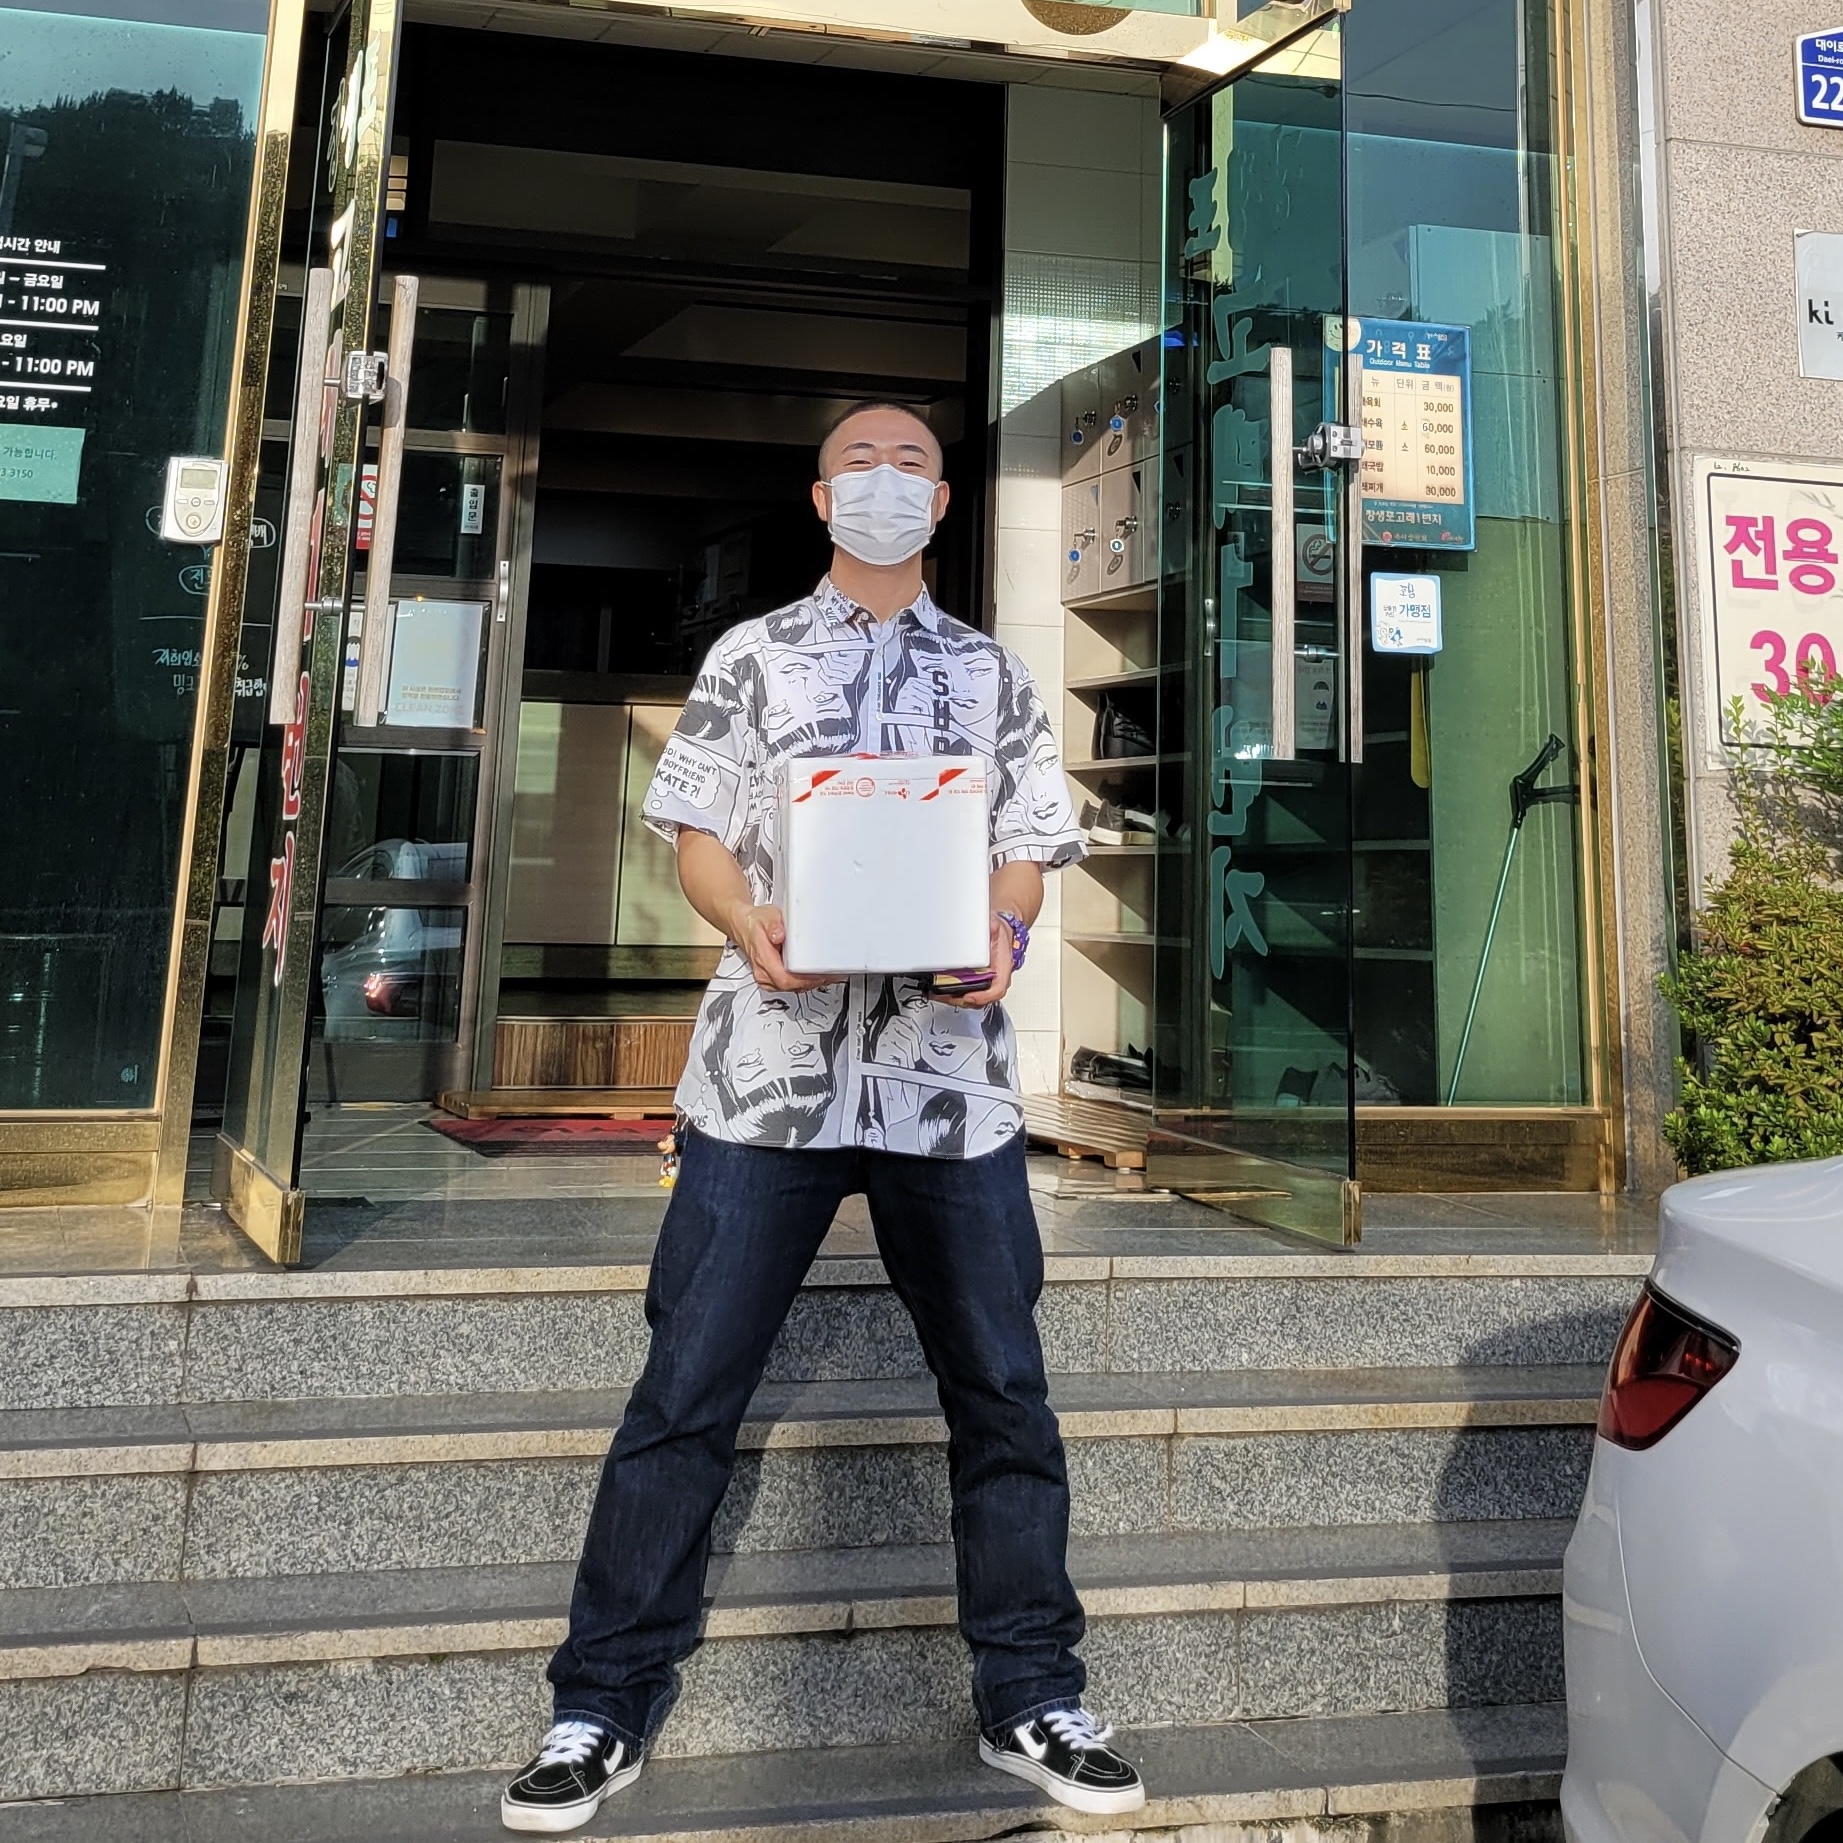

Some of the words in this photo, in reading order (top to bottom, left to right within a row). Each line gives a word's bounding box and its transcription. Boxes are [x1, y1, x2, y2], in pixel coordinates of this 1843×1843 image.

[34, 239, 61, 255] 안내
[24, 273, 64, 289] 금요일
[21, 295, 68, 314] 11:00
[71, 299, 100, 316] PM
[15, 356, 62, 375] 11:00
[66, 360, 95, 377] PM
[1396, 378, 1414, 390] 단위
[1423, 401, 1454, 413] 30,000
[1401, 441, 1409, 452] 소
[1424, 443, 1455, 456] 60,000
[10, 468, 33, 479] 3150
[1426, 465, 1456, 477] 10,000
[468, 488, 479, 522] 출입문
[1723, 514, 1839, 595] 전용
[1750, 630, 1843, 708] 30
[678, 752, 698, 767] WHY
[662, 758, 706, 784] BOYFRIEND
